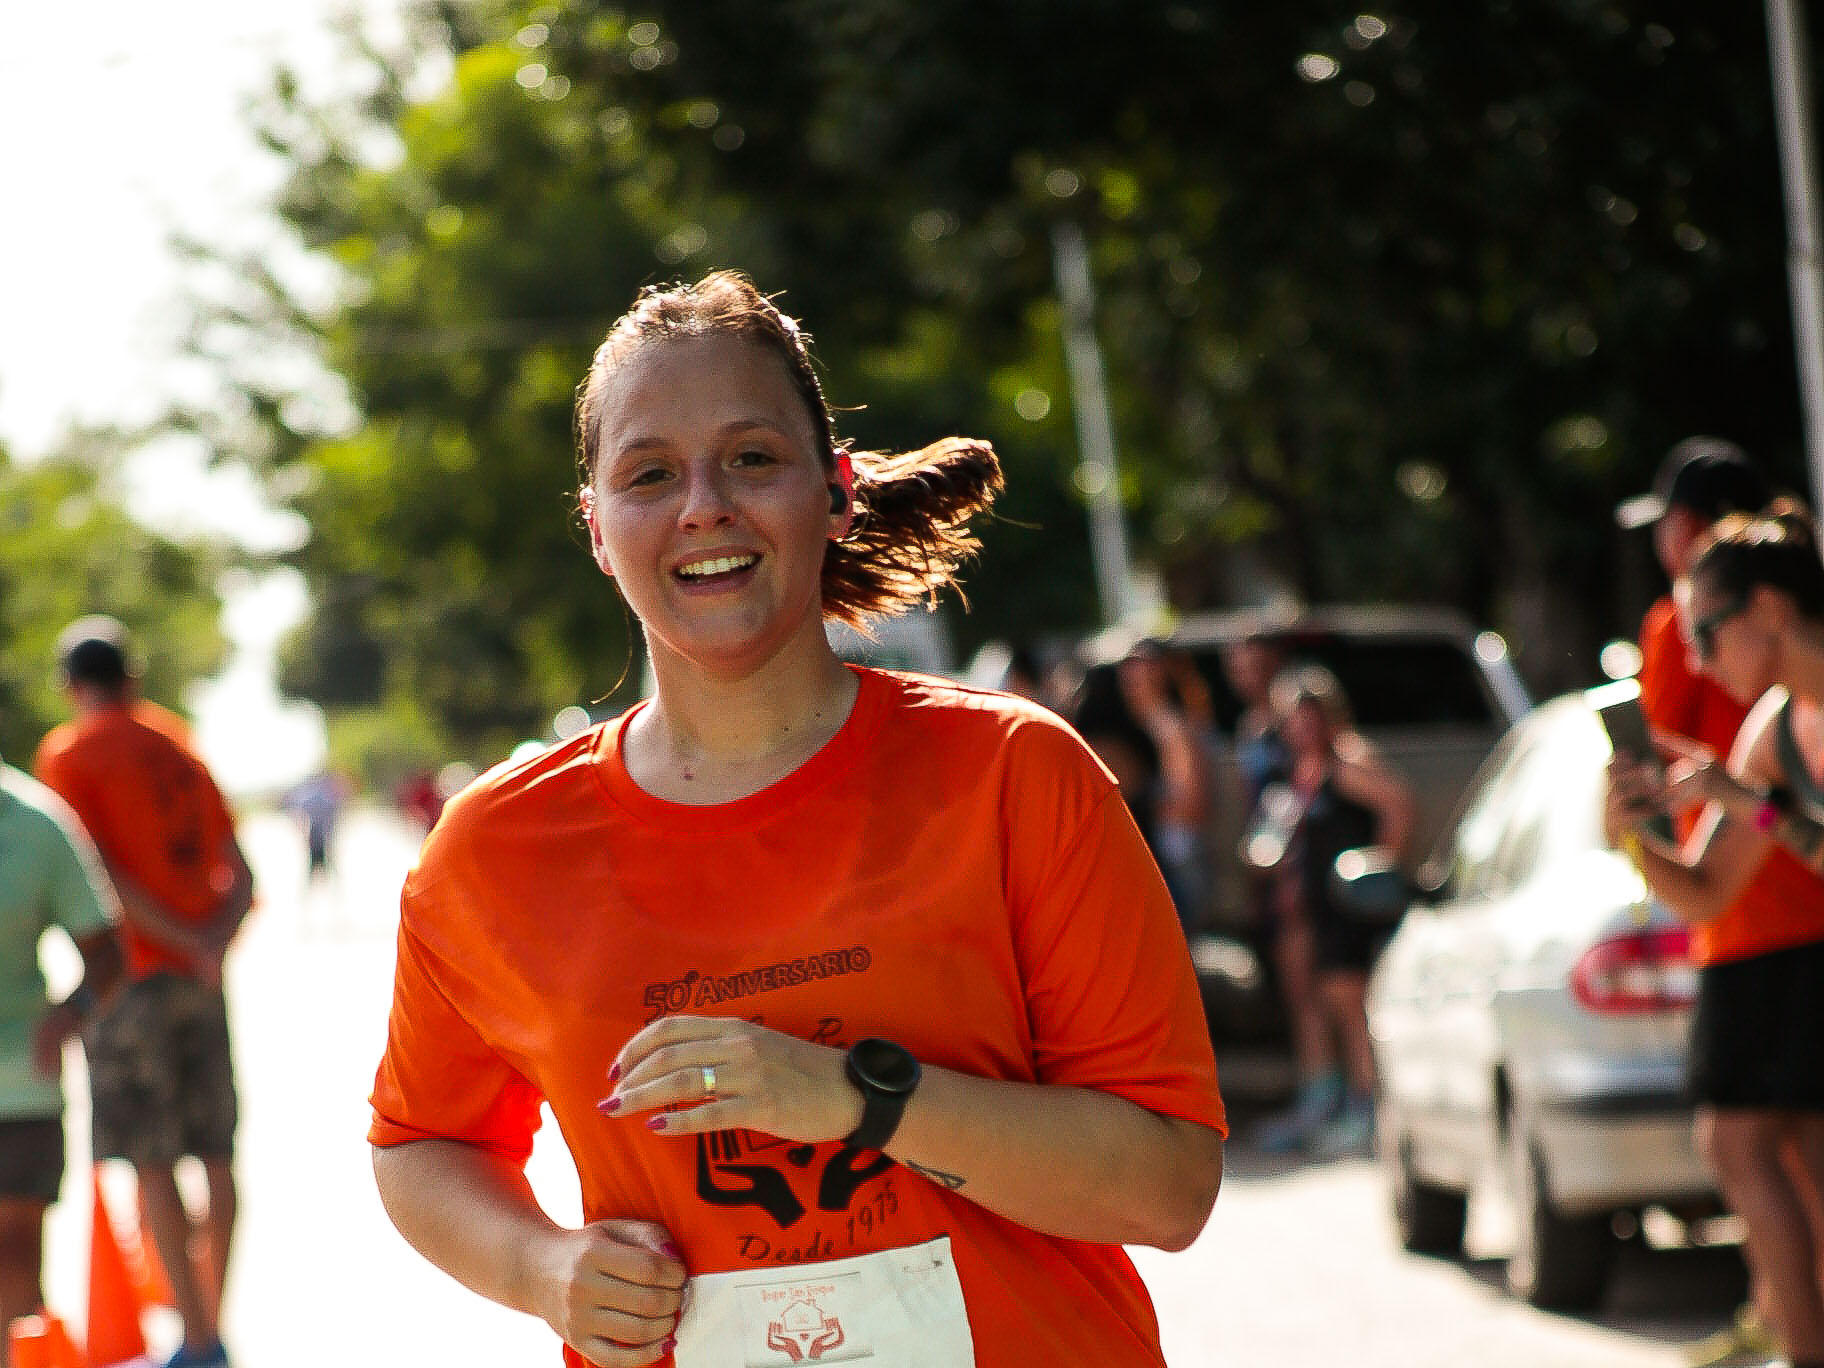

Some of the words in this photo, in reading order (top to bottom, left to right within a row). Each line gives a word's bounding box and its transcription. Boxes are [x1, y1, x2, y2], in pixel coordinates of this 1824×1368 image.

[694, 946, 873, 1008] ANIVERSARIO
[737, 1230, 834, 1263] Desde
[846, 1181, 899, 1245] 1975
